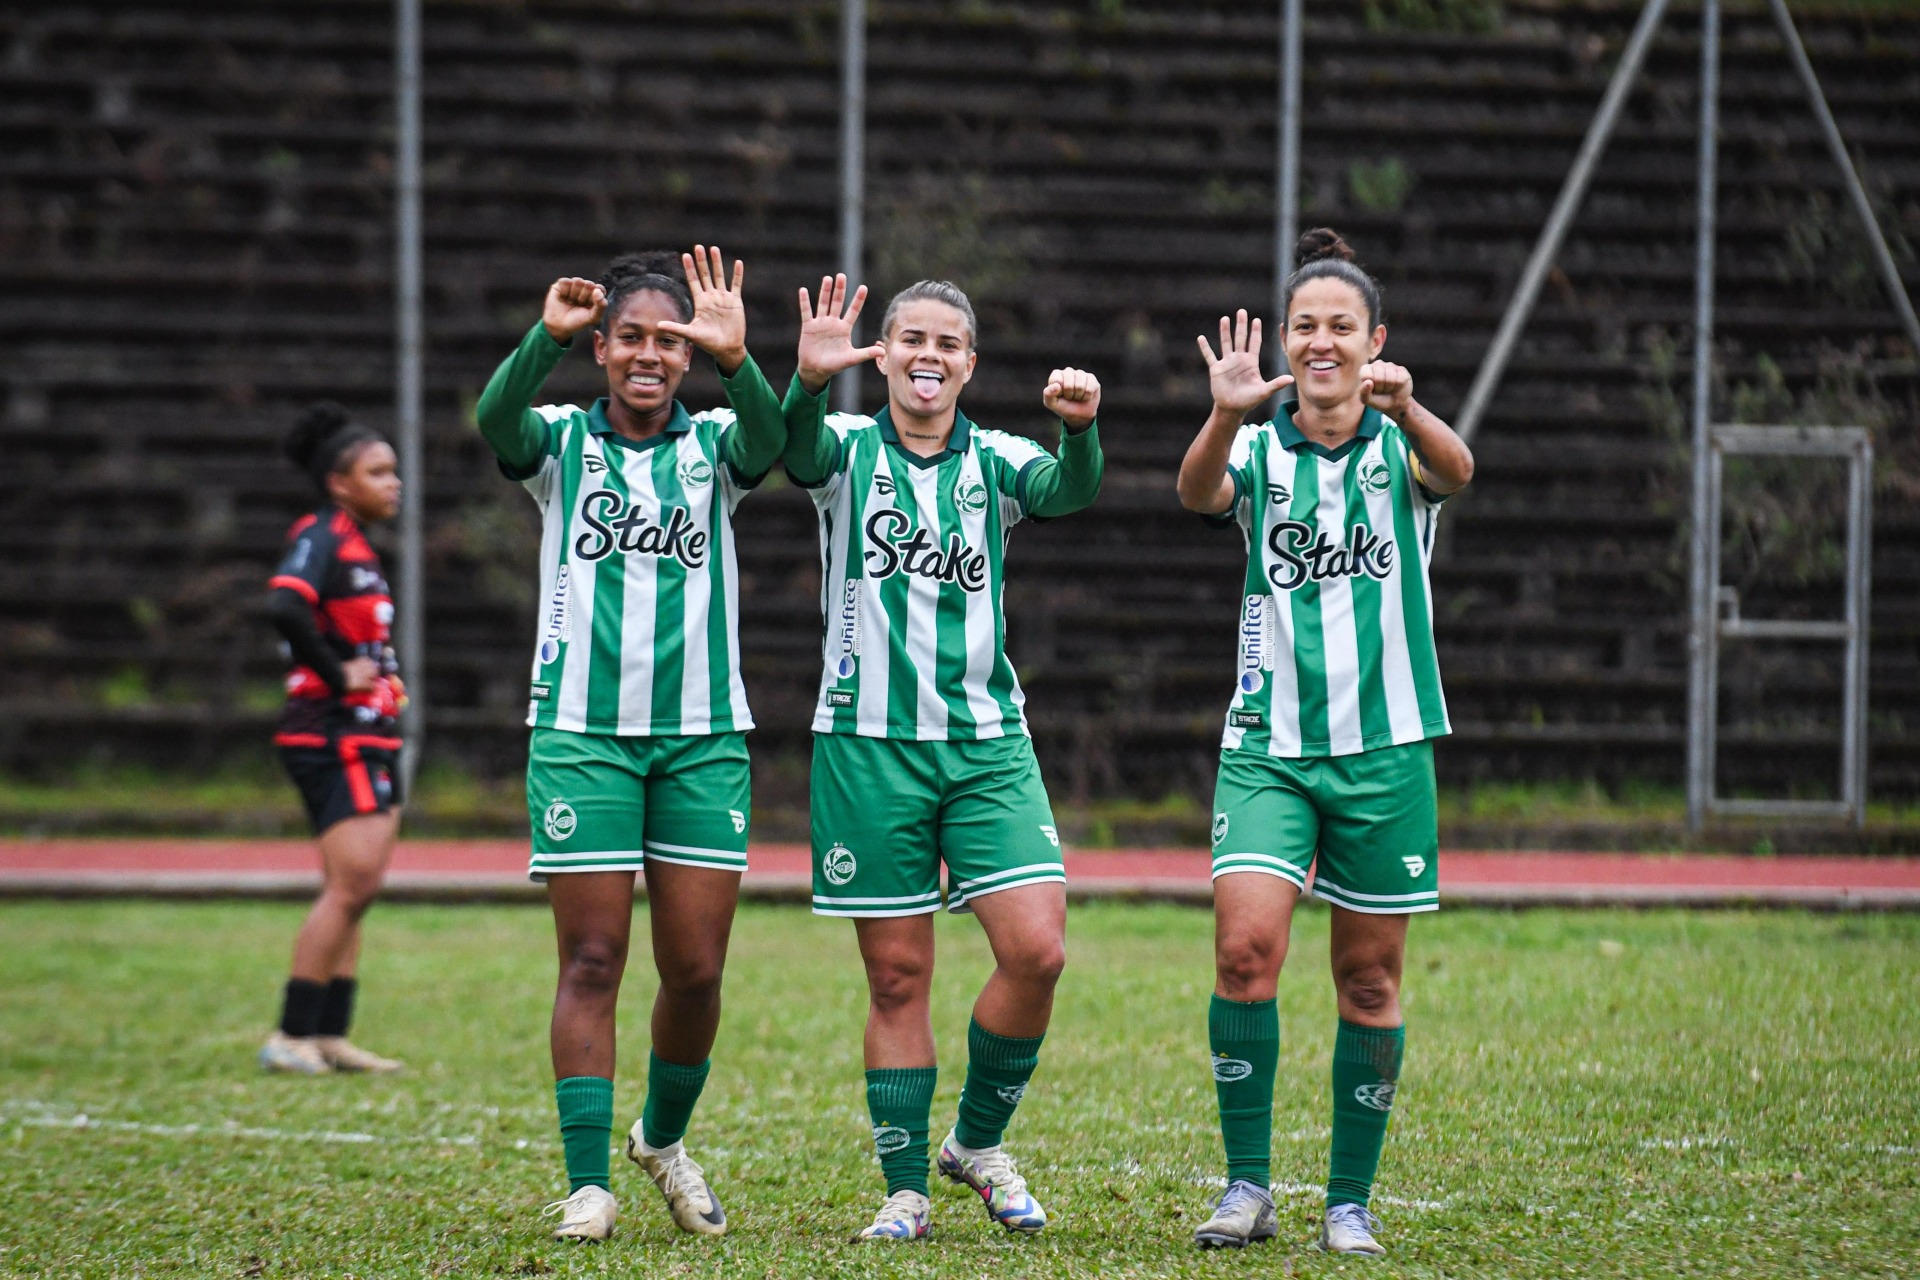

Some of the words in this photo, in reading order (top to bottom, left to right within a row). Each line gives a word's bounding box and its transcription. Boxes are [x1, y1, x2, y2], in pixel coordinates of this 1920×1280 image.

[574, 491, 707, 570] Stake
[864, 509, 986, 593] Stake
[1268, 522, 1394, 590] Stake
[842, 580, 856, 654] Uniftec
[1242, 596, 1262, 669] Uniftec
[1265, 645, 1273, 670] centro
